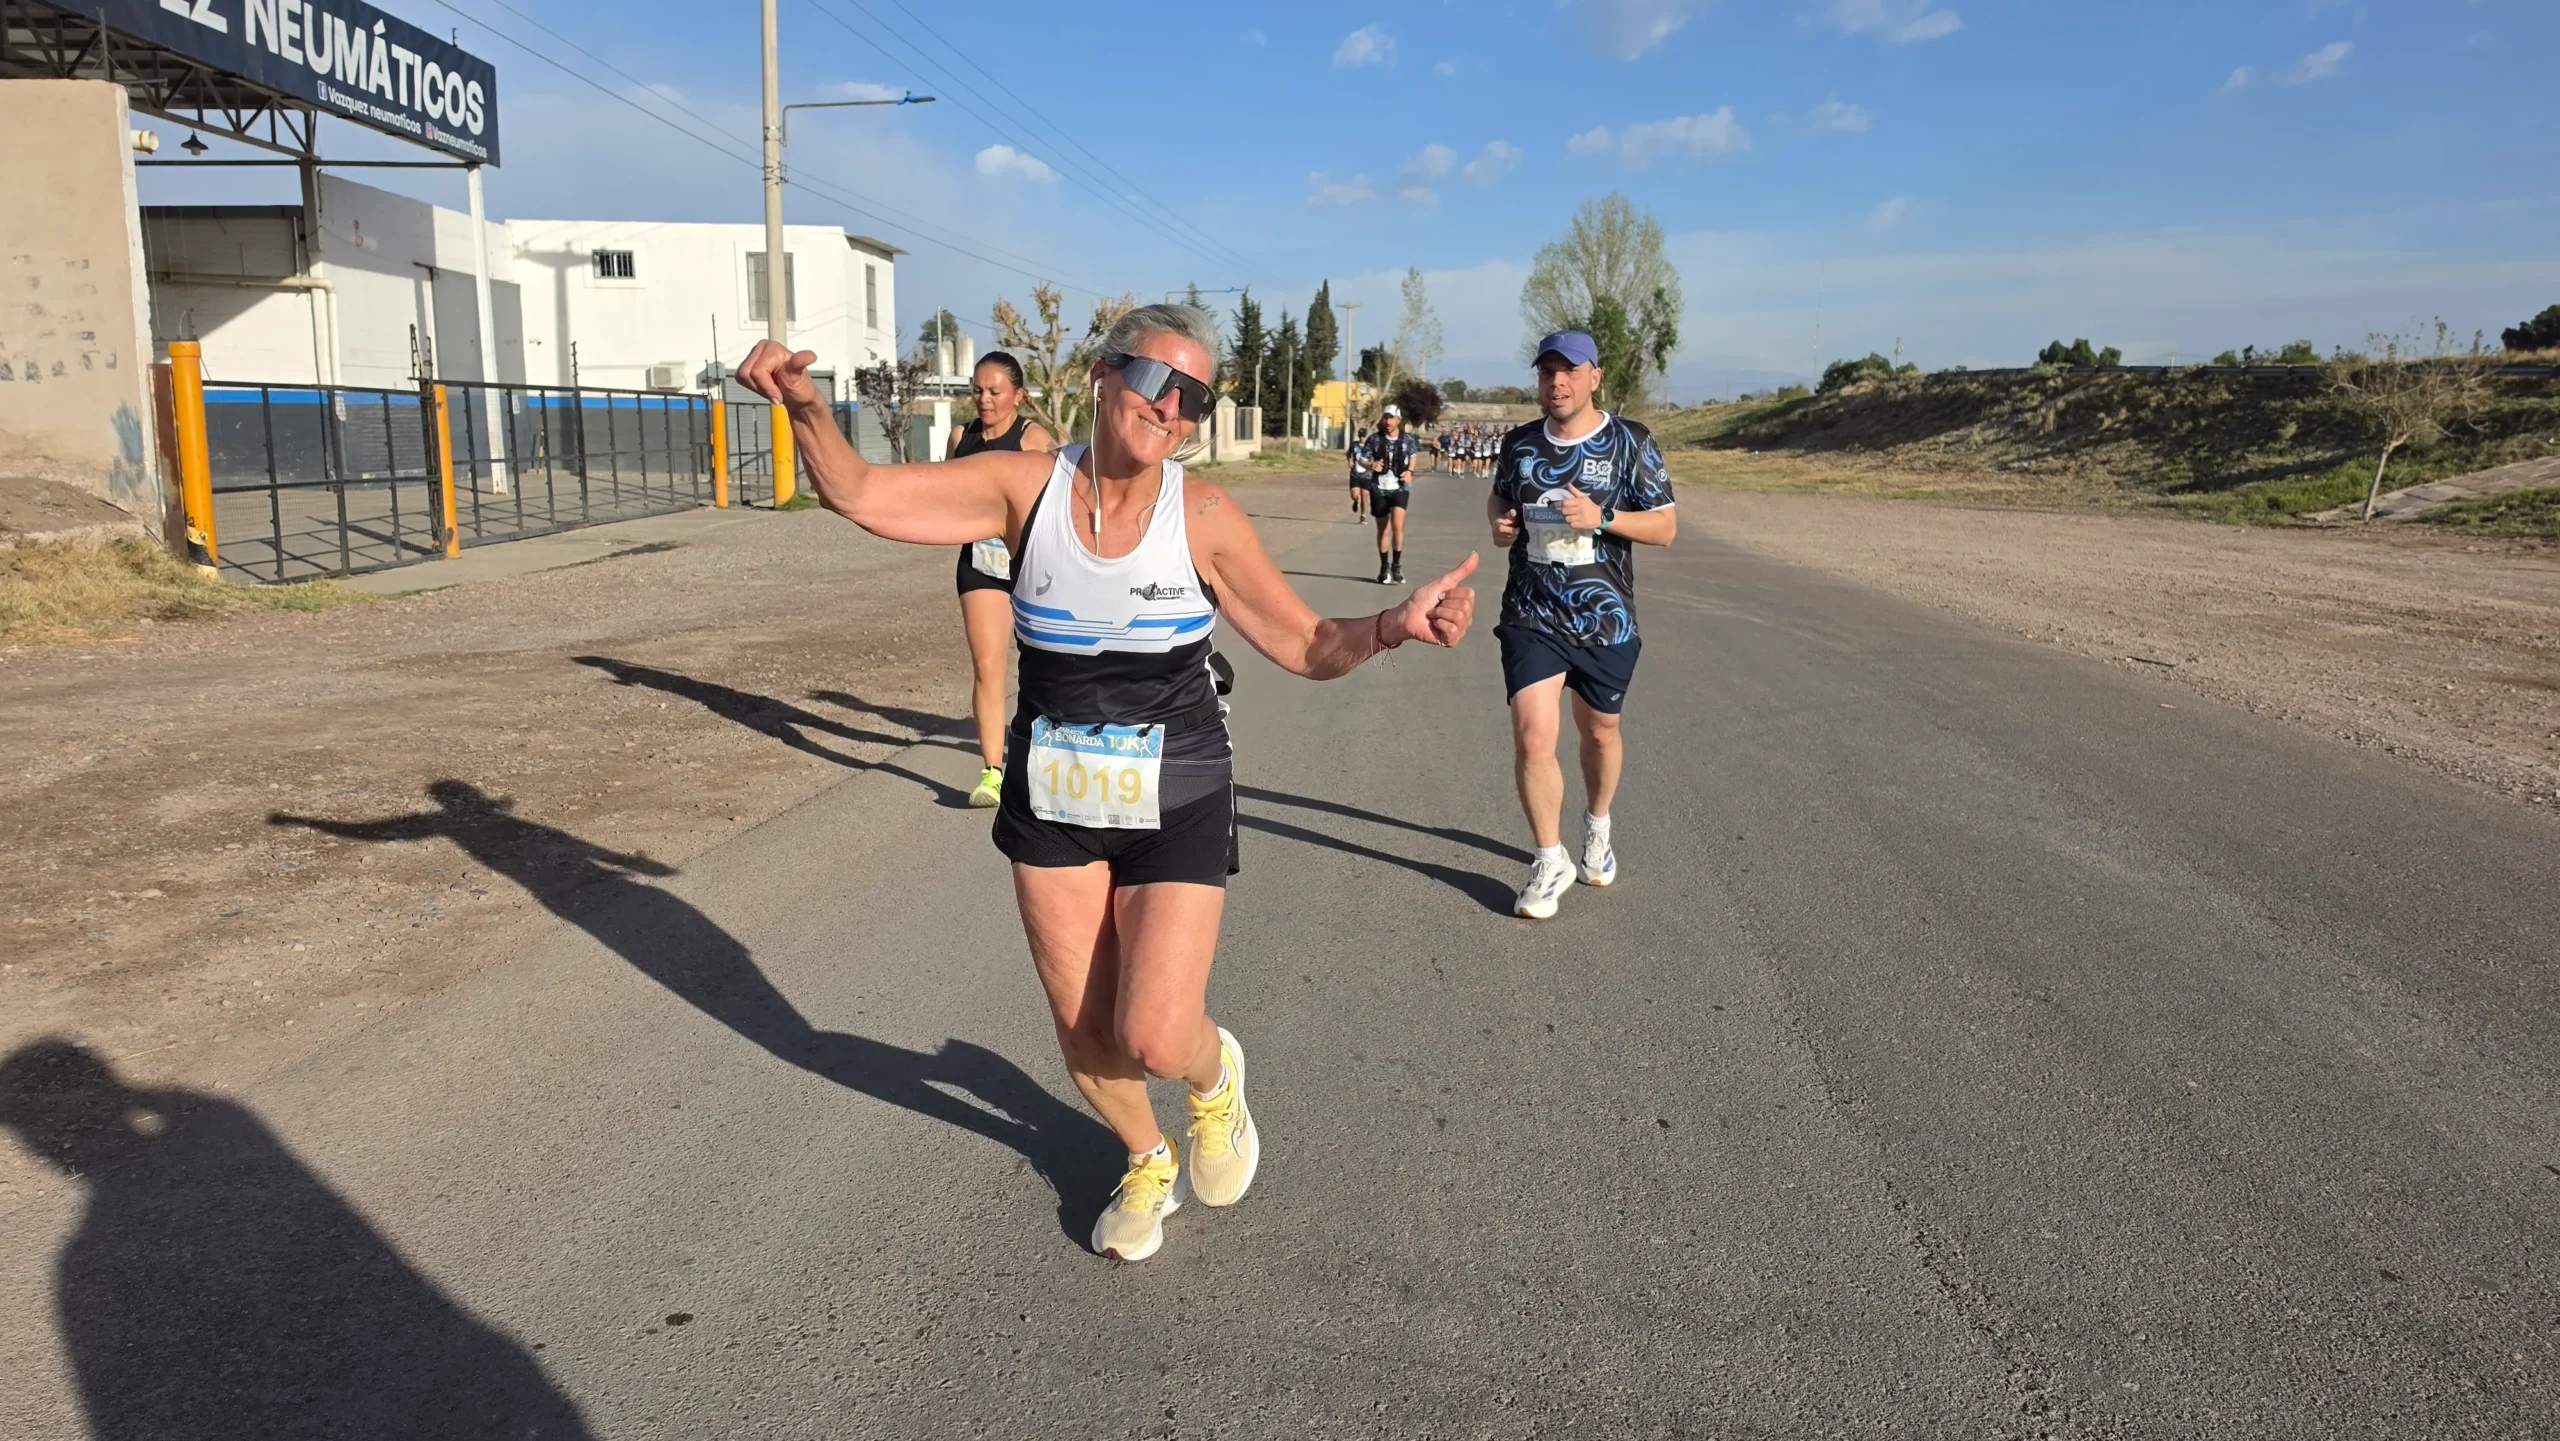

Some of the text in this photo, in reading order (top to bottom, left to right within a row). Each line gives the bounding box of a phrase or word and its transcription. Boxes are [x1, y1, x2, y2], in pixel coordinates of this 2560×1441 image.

[245, 0, 484, 135] NEUMÁTICOS
[328, 86, 422, 135] Vazquez neumaticos
[1055, 731, 1105, 747] BONARDA
[1043, 760, 1142, 805] 1019
